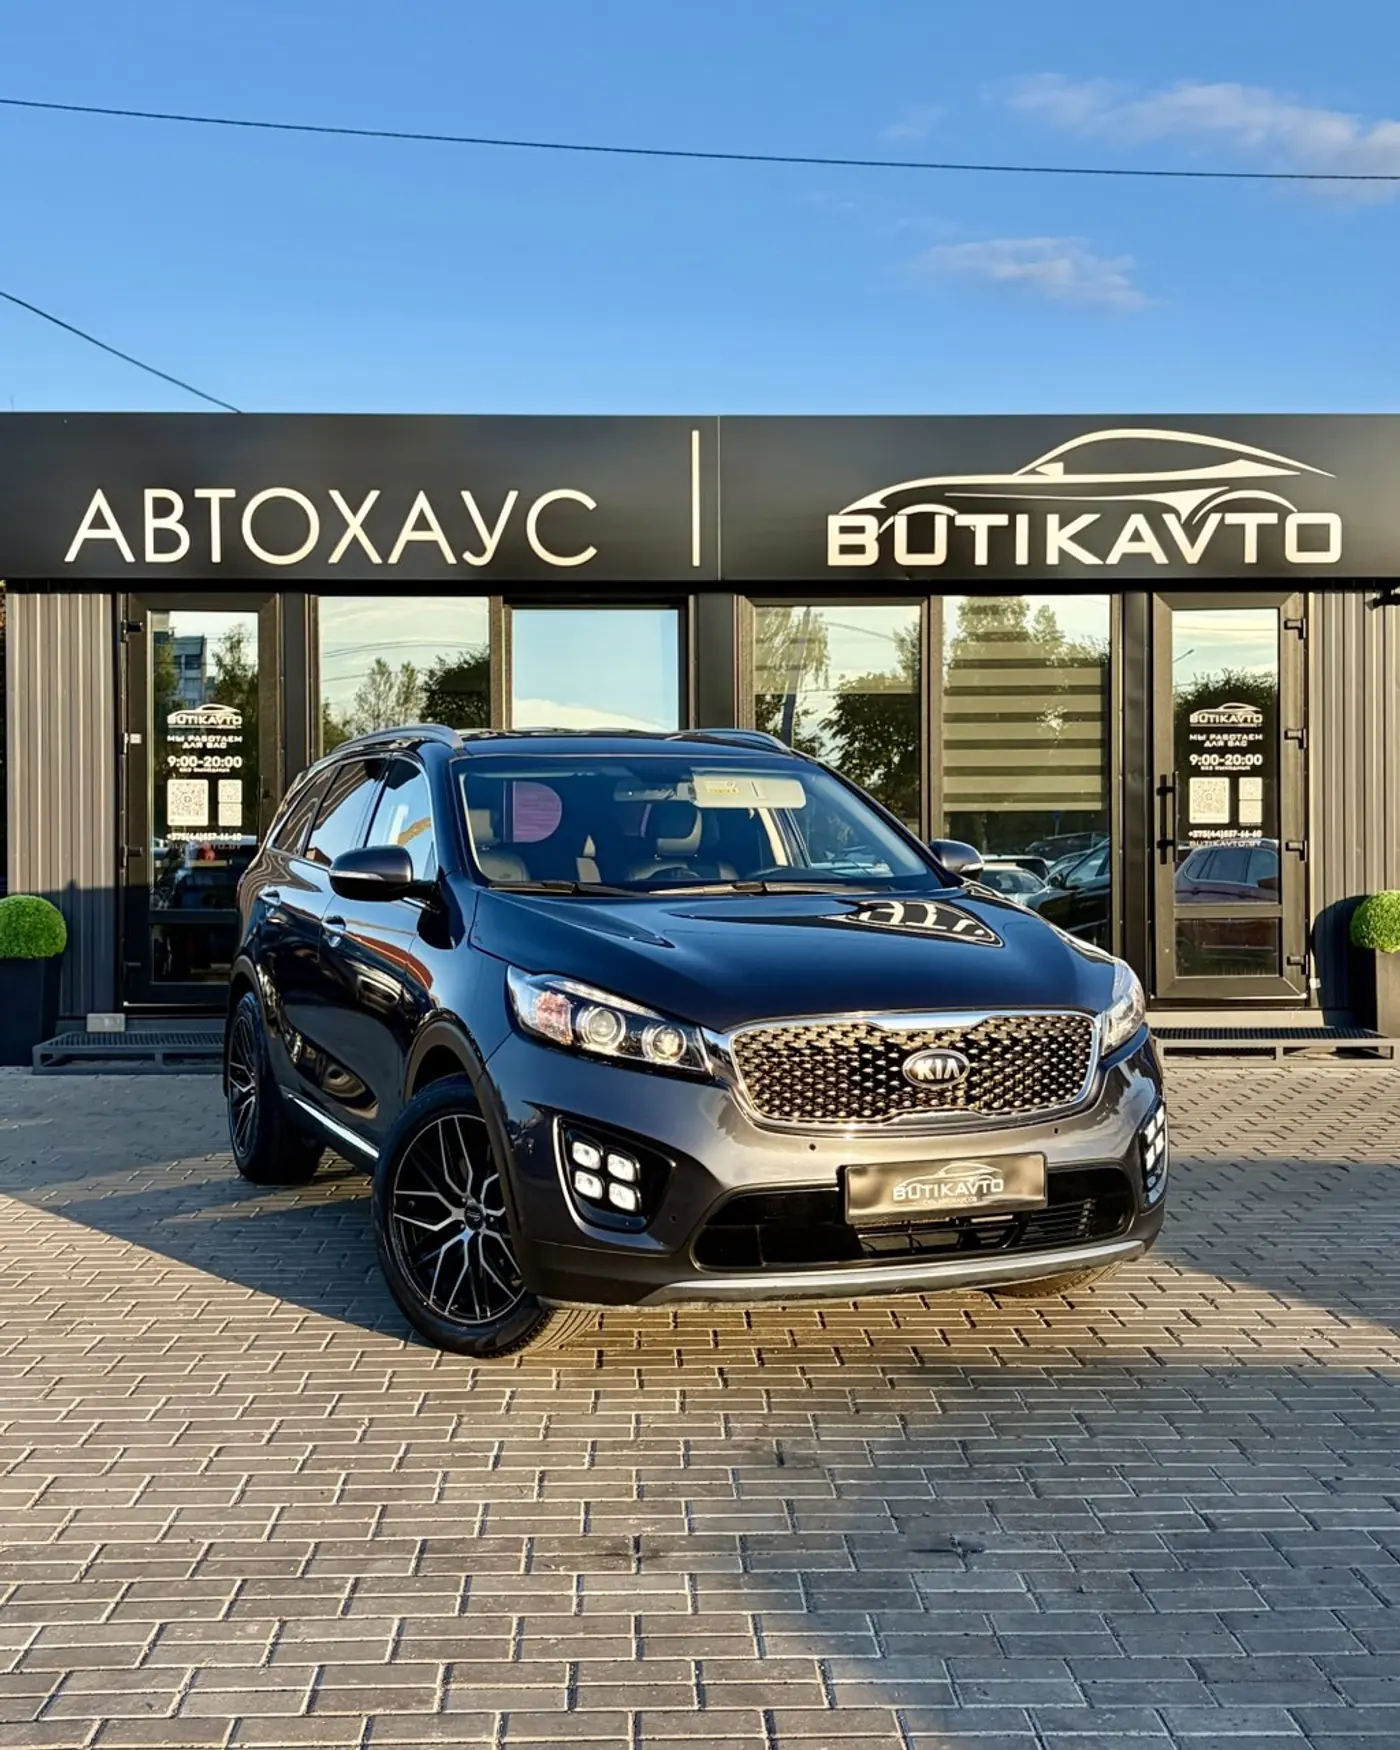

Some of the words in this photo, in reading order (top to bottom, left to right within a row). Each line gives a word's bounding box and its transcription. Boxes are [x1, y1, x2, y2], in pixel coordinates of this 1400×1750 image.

[64, 487, 598, 566] АВТОХАУС
[827, 512, 1343, 566] BUTIKAVTO
[167, 714, 242, 725] BUTIKAVTO
[1189, 714, 1263, 724] BUTIKAVTO
[187, 735, 243, 743] РАБОТАЕМ
[167, 755, 243, 767] 9:00-20:00
[1189, 754, 1263, 766] 9:00-20:00
[917, 1058, 960, 1081] KIA
[893, 1179, 1004, 1201] BUTIKAVTO
